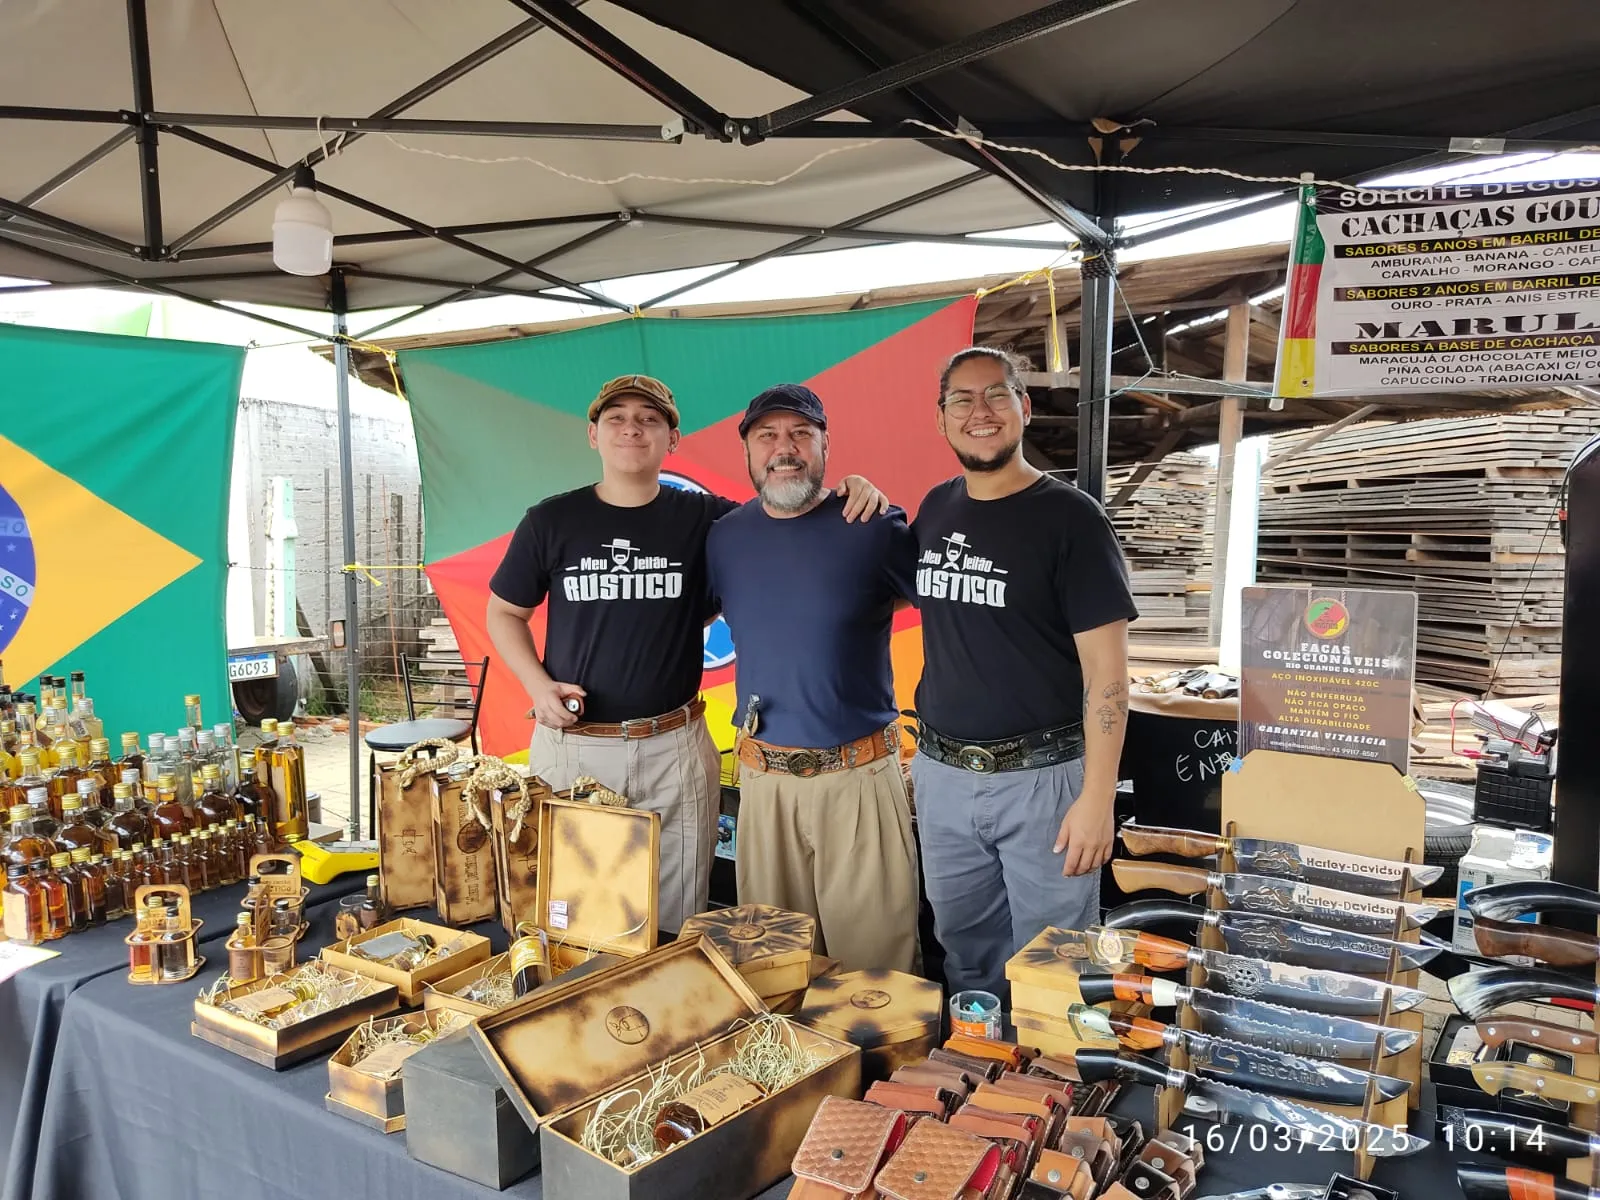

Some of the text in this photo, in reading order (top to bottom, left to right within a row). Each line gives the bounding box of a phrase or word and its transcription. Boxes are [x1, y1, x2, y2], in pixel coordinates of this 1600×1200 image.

[1339, 184, 1473, 207] SOLICITE
[1341, 197, 1600, 238] CACHAÇAS GOU
[1345, 228, 1600, 257] SABORES 5 ANOS EM BARRIL DE
[1371, 255, 1452, 268] AMBURANA
[1465, 250, 1529, 262] BANANA
[1381, 266, 1460, 279] CARVALHO
[1473, 260, 1554, 273] MORANGO
[1346, 275, 1600, 300] SABORES 2 ANOS EM BARRIL DE
[1391, 289, 1600, 310] OURO PRATA ANIS ESTRE
[1354, 312, 1600, 339] MARUL
[1349, 335, 1595, 353] SABORES A BASE DE CACHAÇA
[1359, 349, 1597, 365] MARACUJÁ C/ CHOCOLATE MEIO
[1424, 364, 1485, 374] COLADA
[1489, 361, 1560, 373] (ABACAXI
[1565, 361, 1581, 370] C/
[1380, 373, 1584, 385] CAPUCCINO TRADICIONAL
[580, 556, 668, 571] Meu Jeitão
[922, 549, 993, 573] Meu Jeitão
[1300, 642, 1351, 655] FACAS
[1262, 650, 1390, 668] COLECIONÁVEIS
[1303, 664, 1340, 673] GRANDE
[1342, 666, 1355, 674] DO
[1358, 668, 1375, 676] SUL
[1271, 672, 1380, 688] AÇO INOXIDÁVEL 420C
[1284, 697, 1367, 712] NÃO FICA OPACO
[1287, 689, 1364, 703] NÃO ENFERRUJA
[1278, 714, 1371, 731] ALTA DURABILIDADE
[1289, 706, 1360, 721] MANTÉM O FIO
[1258, 725, 1387, 746] GARANTIA VITALÍCIA
[1306, 857, 1401, 876] Harley-Davidso
[1298, 894, 1398, 915] Harley-Davidso
[1294, 934, 1391, 954] Harley-Davids
